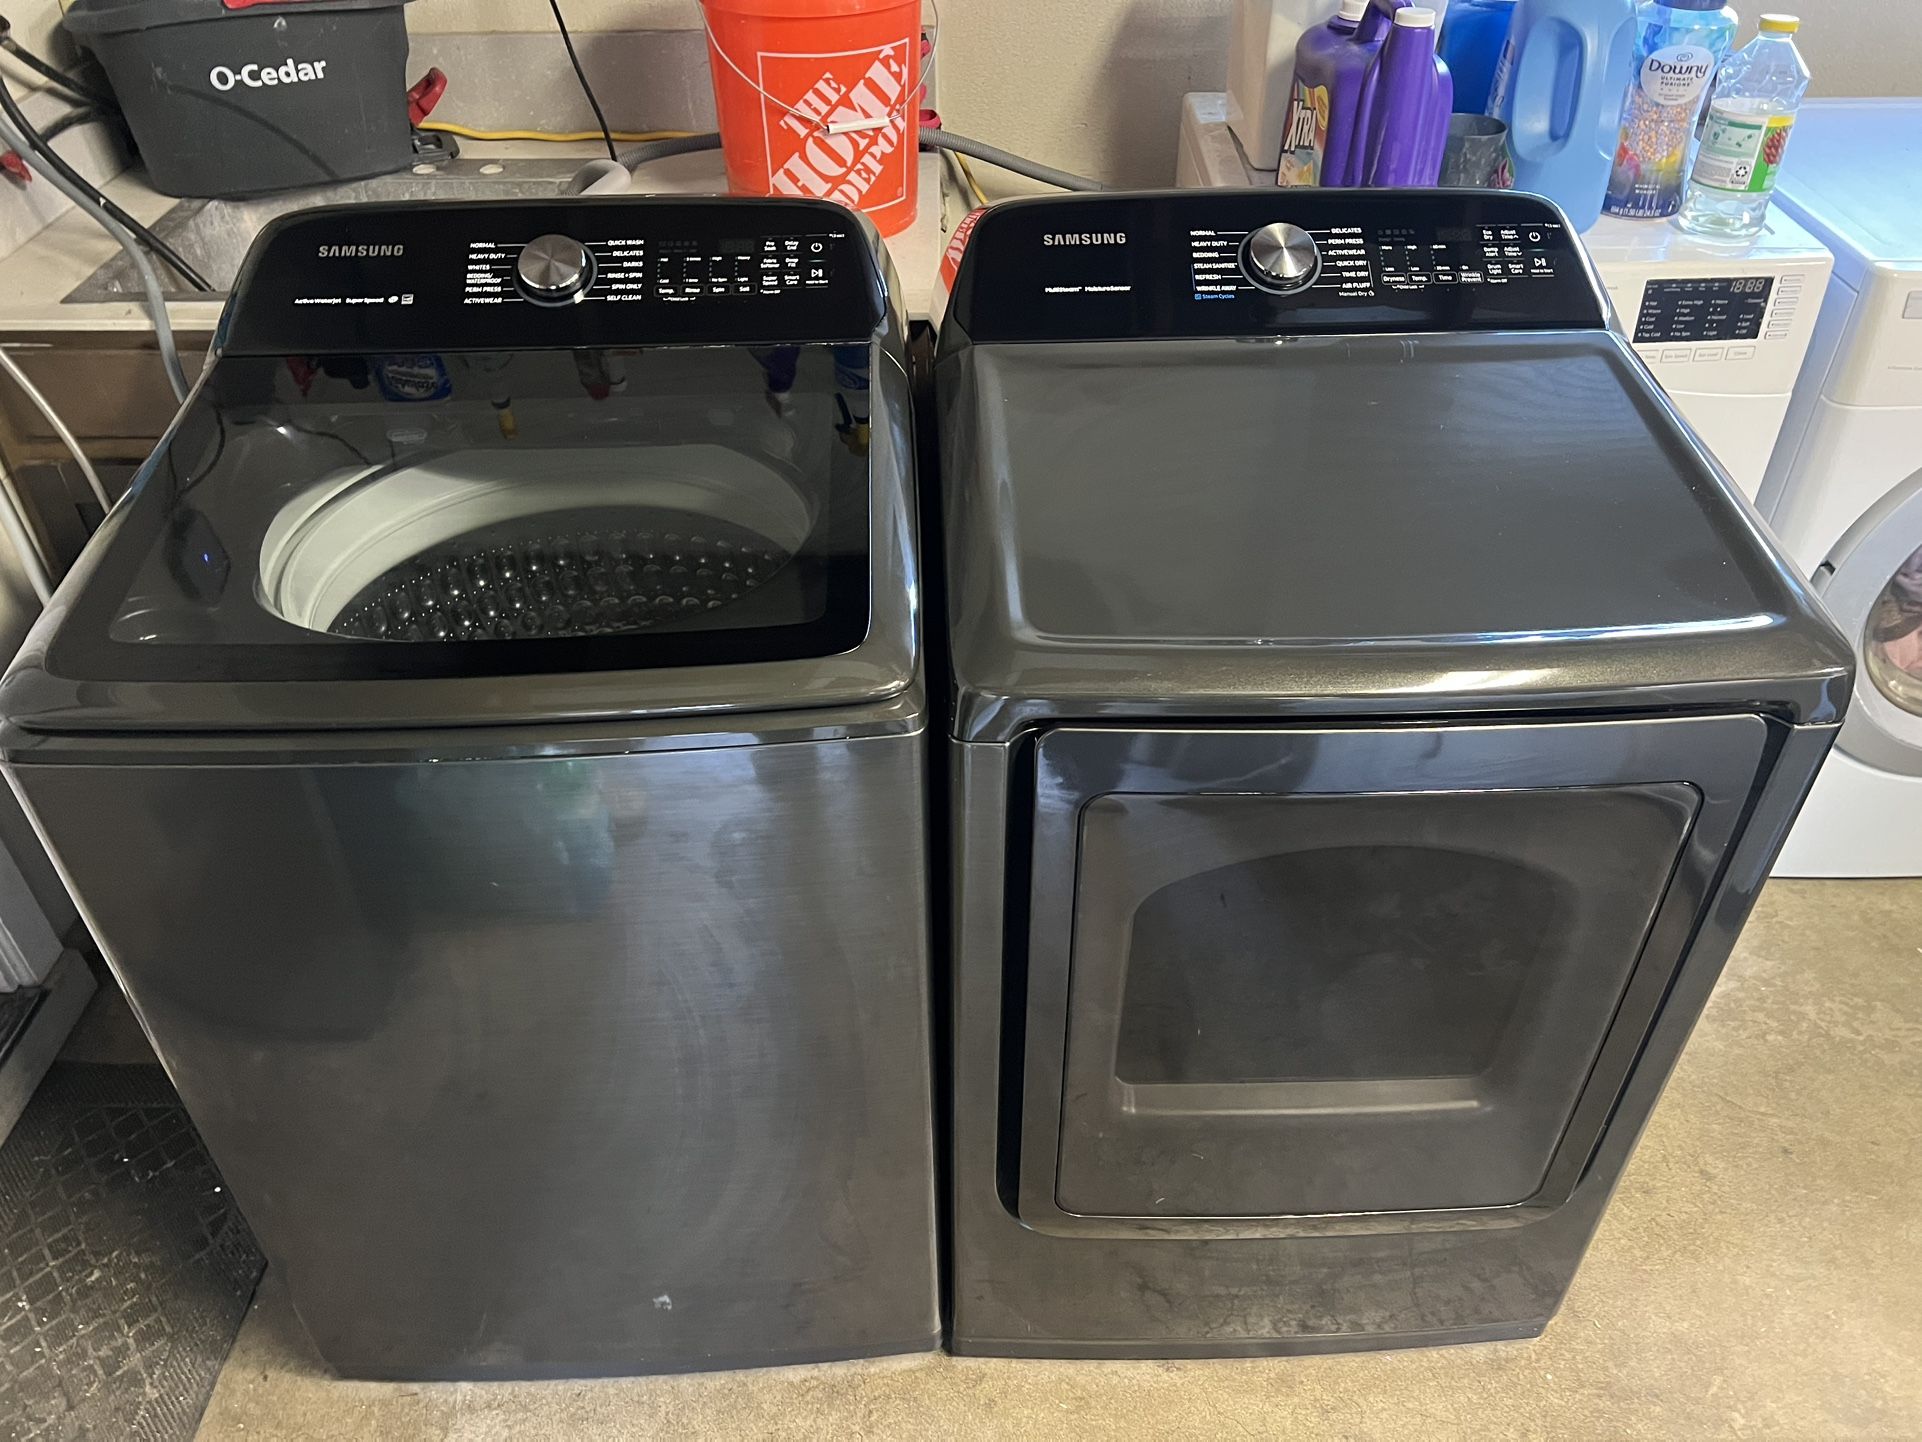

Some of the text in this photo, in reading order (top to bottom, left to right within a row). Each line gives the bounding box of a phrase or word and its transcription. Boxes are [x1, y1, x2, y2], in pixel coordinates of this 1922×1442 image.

[209, 58, 328, 91] O-Cedar
[1648, 58, 1708, 78] Downy
[779, 71, 847, 139] THE
[771, 47, 908, 197] HOME
[828, 104, 906, 208] DEPOT
[318, 245, 404, 257] SAMSUNG
[1043, 232, 1126, 246] SAMSUNG
